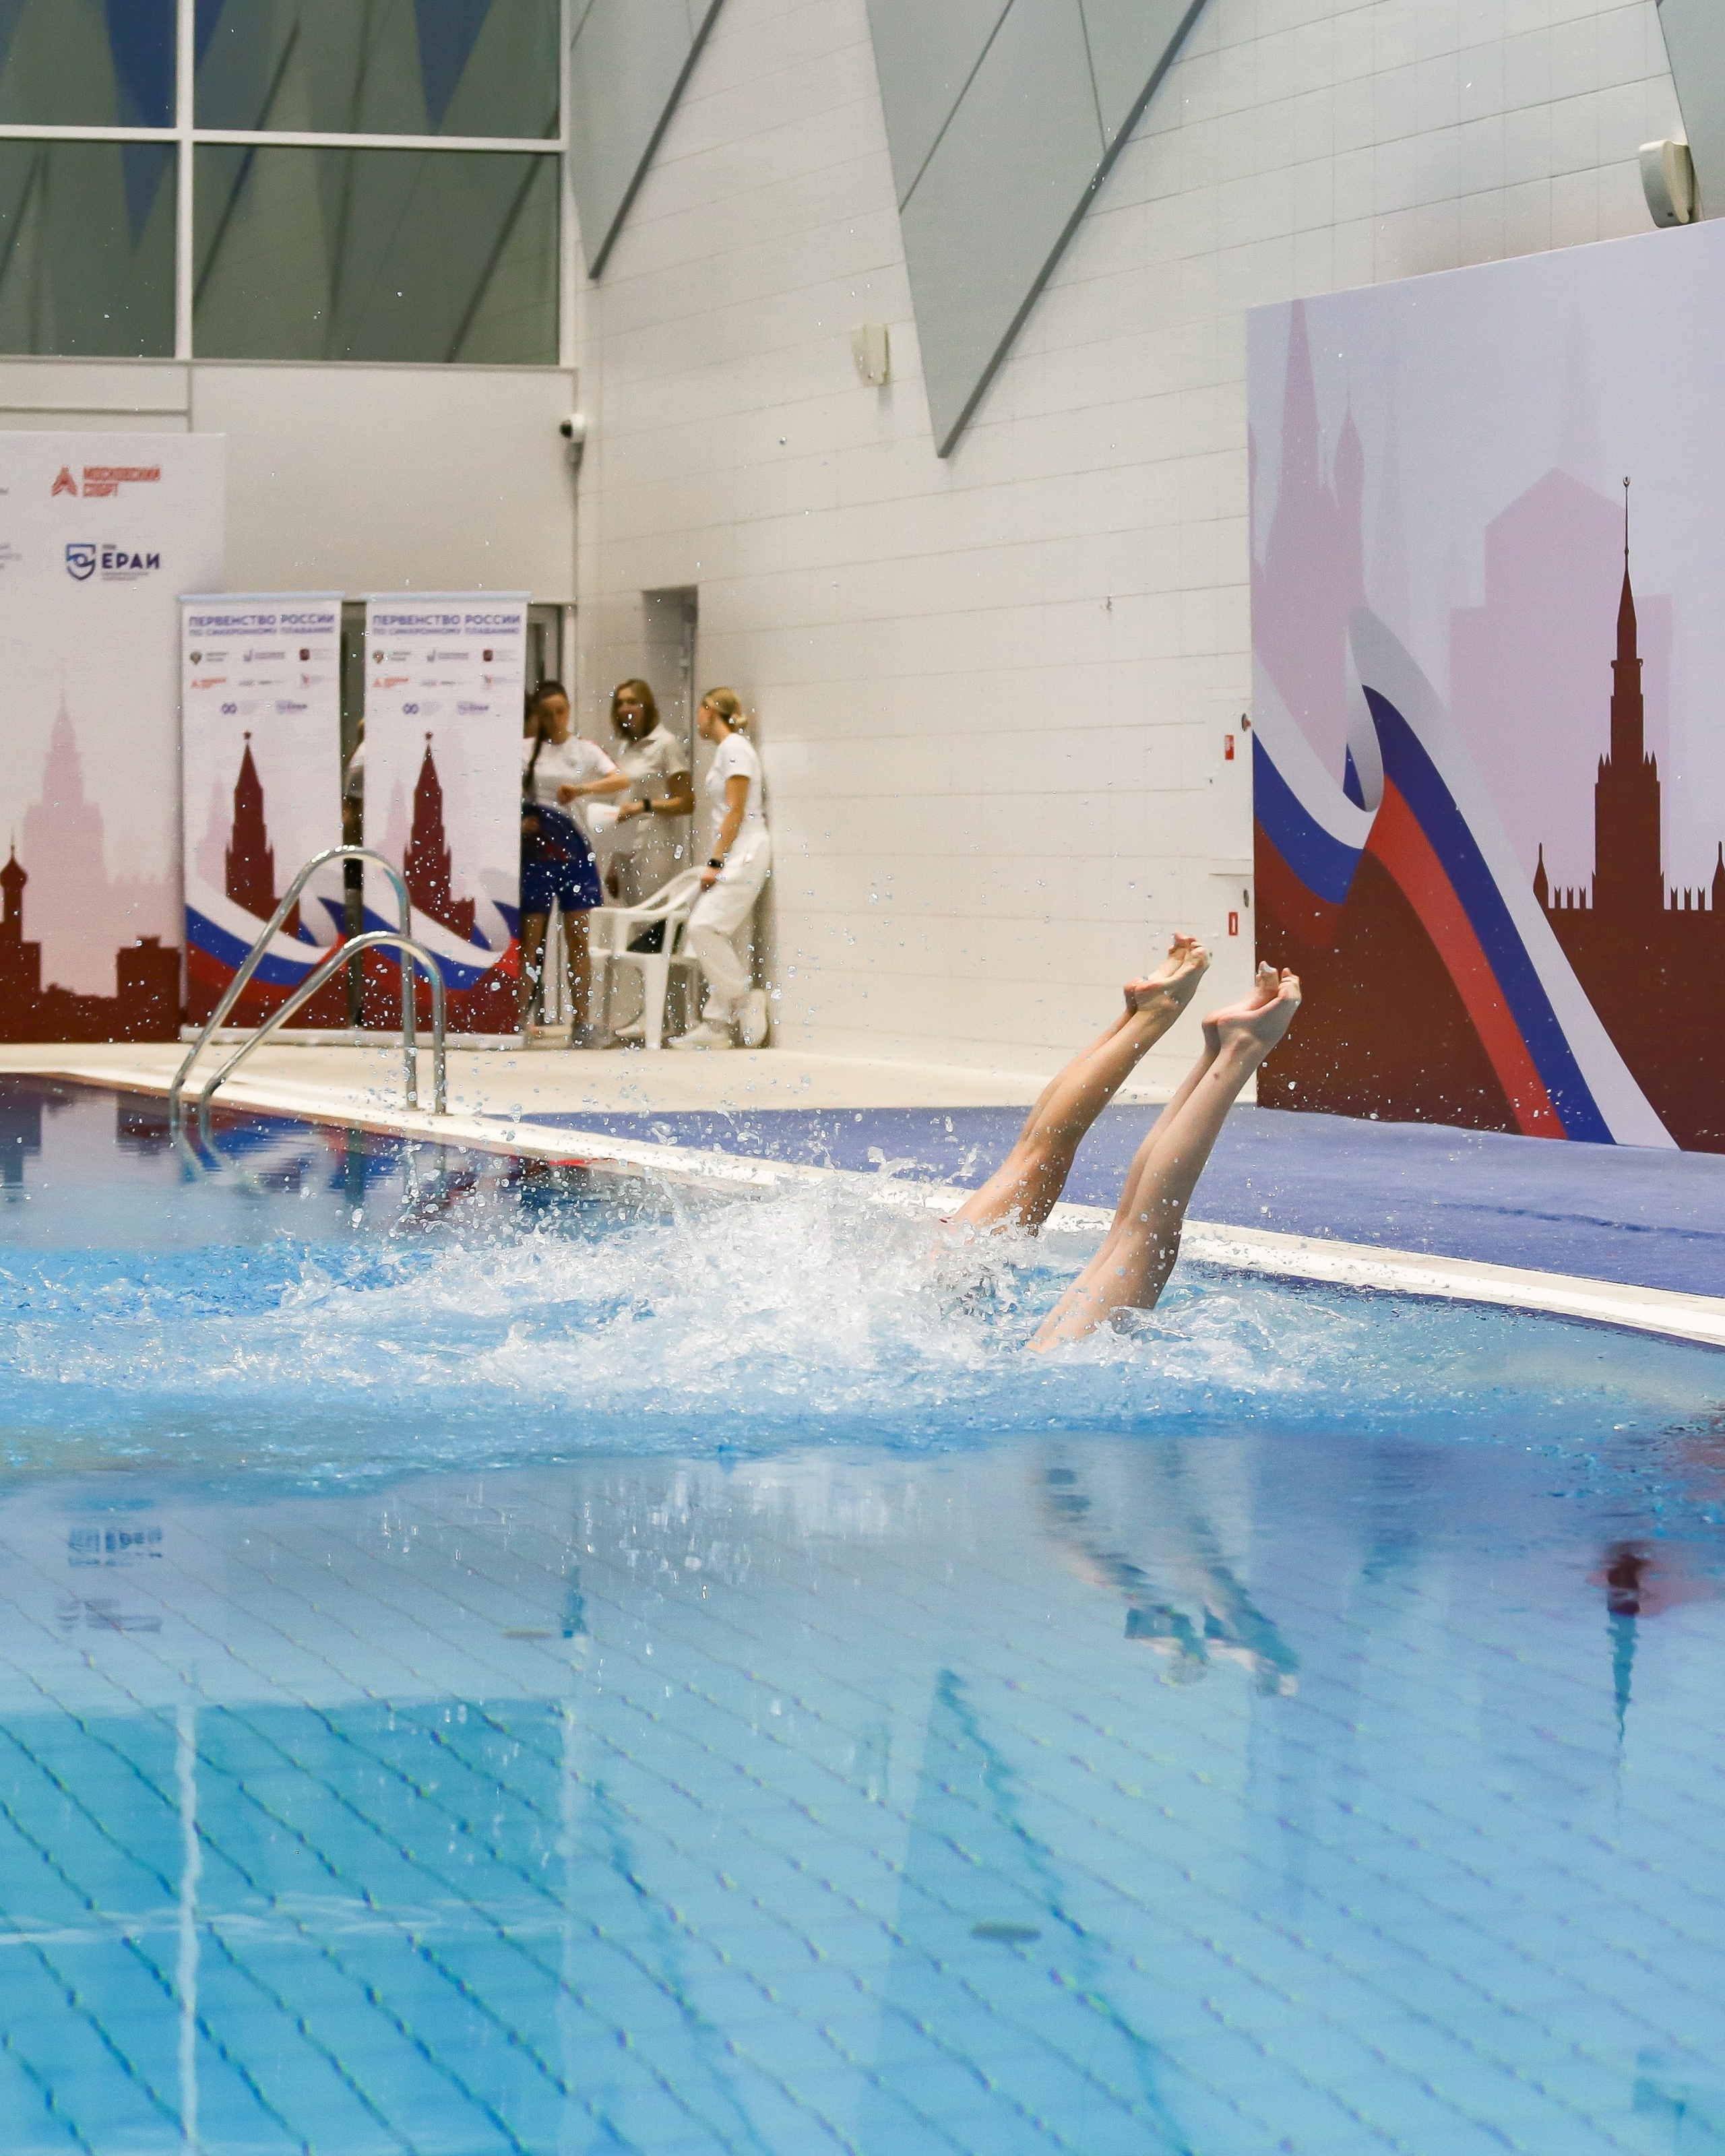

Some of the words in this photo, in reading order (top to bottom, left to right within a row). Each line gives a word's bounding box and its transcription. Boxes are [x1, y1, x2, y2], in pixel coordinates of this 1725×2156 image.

[102, 552, 160, 569] ЕРАИ
[189, 615, 277, 627] ПЕРВЕНСТВО
[280, 614, 335, 624] РОССИИ
[373, 614, 461, 625] ПЕРВЕНСТВО
[465, 614, 521, 625] РОССИИ
